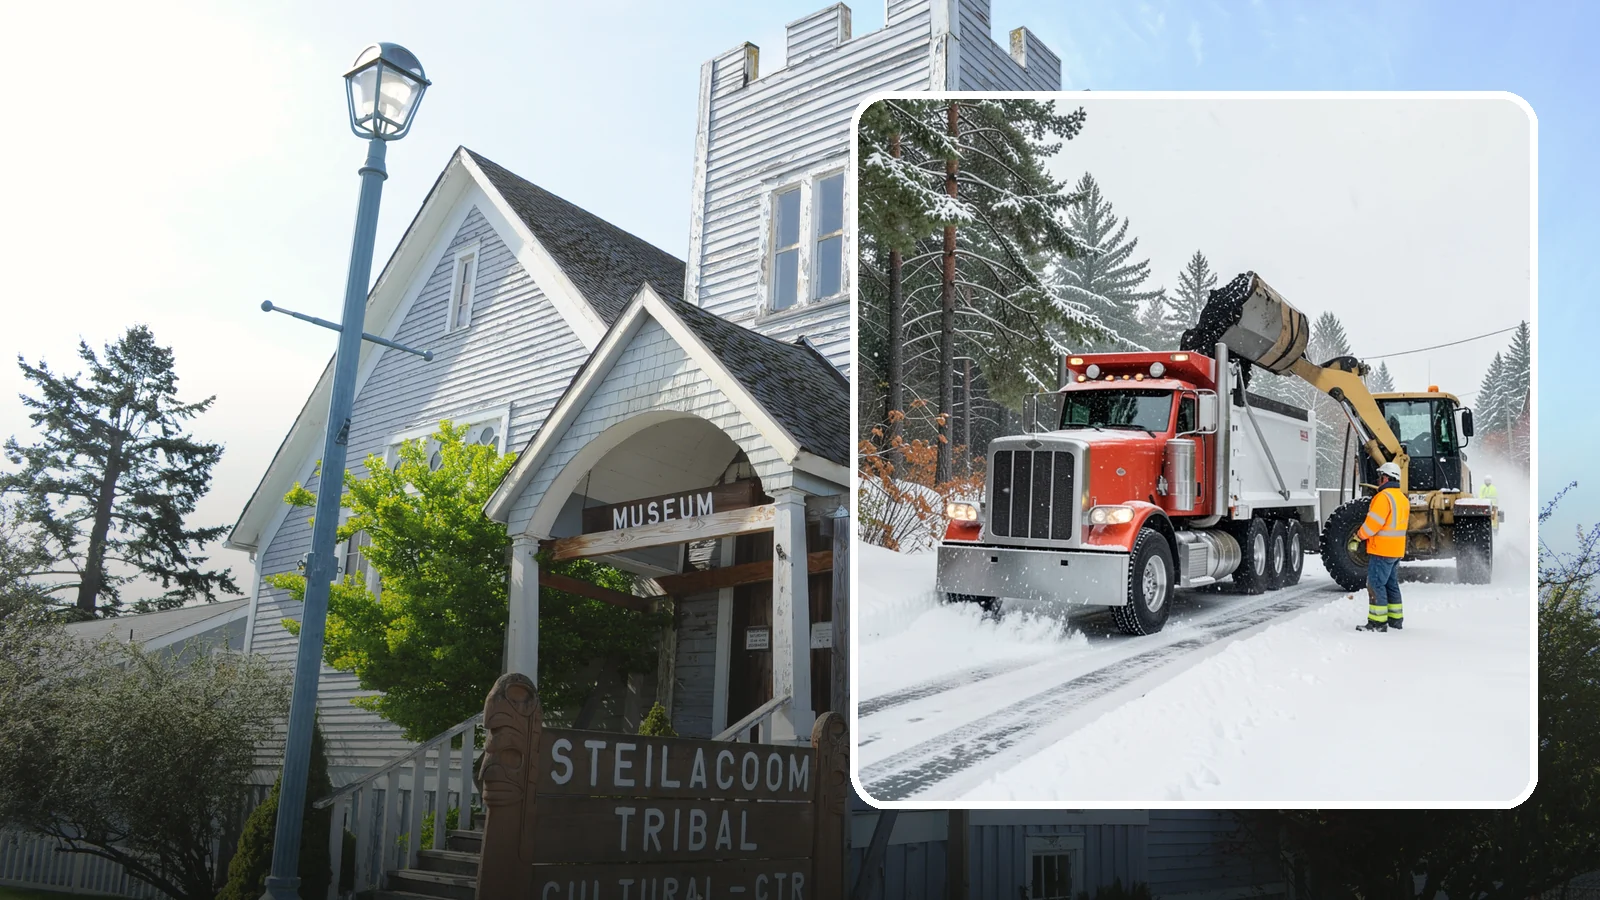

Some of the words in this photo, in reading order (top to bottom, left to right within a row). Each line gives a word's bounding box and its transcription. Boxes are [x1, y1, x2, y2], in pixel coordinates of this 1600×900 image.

[612, 491, 714, 531] MUSEUM
[550, 738, 810, 793] STEILACOOM
[614, 806, 758, 852] TRIBAL
